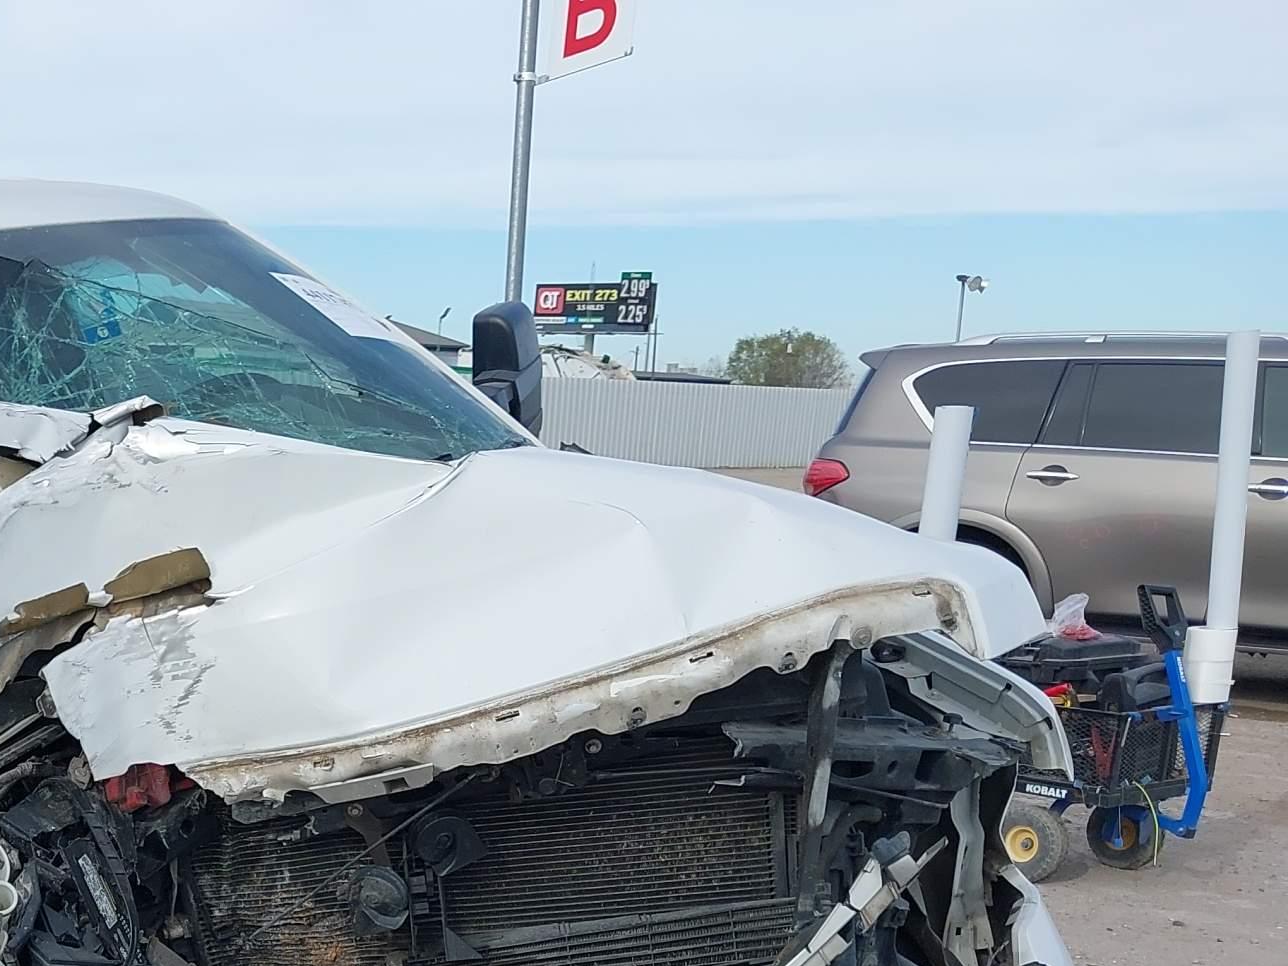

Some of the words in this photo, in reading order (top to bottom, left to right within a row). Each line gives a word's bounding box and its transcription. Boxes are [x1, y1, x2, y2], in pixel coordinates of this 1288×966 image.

[563, 0, 617, 58] B
[540, 291, 561, 309] QT
[565, 289, 593, 302] EXIT
[594, 289, 618, 301] 273
[1025, 783, 1068, 799] KOBALT
